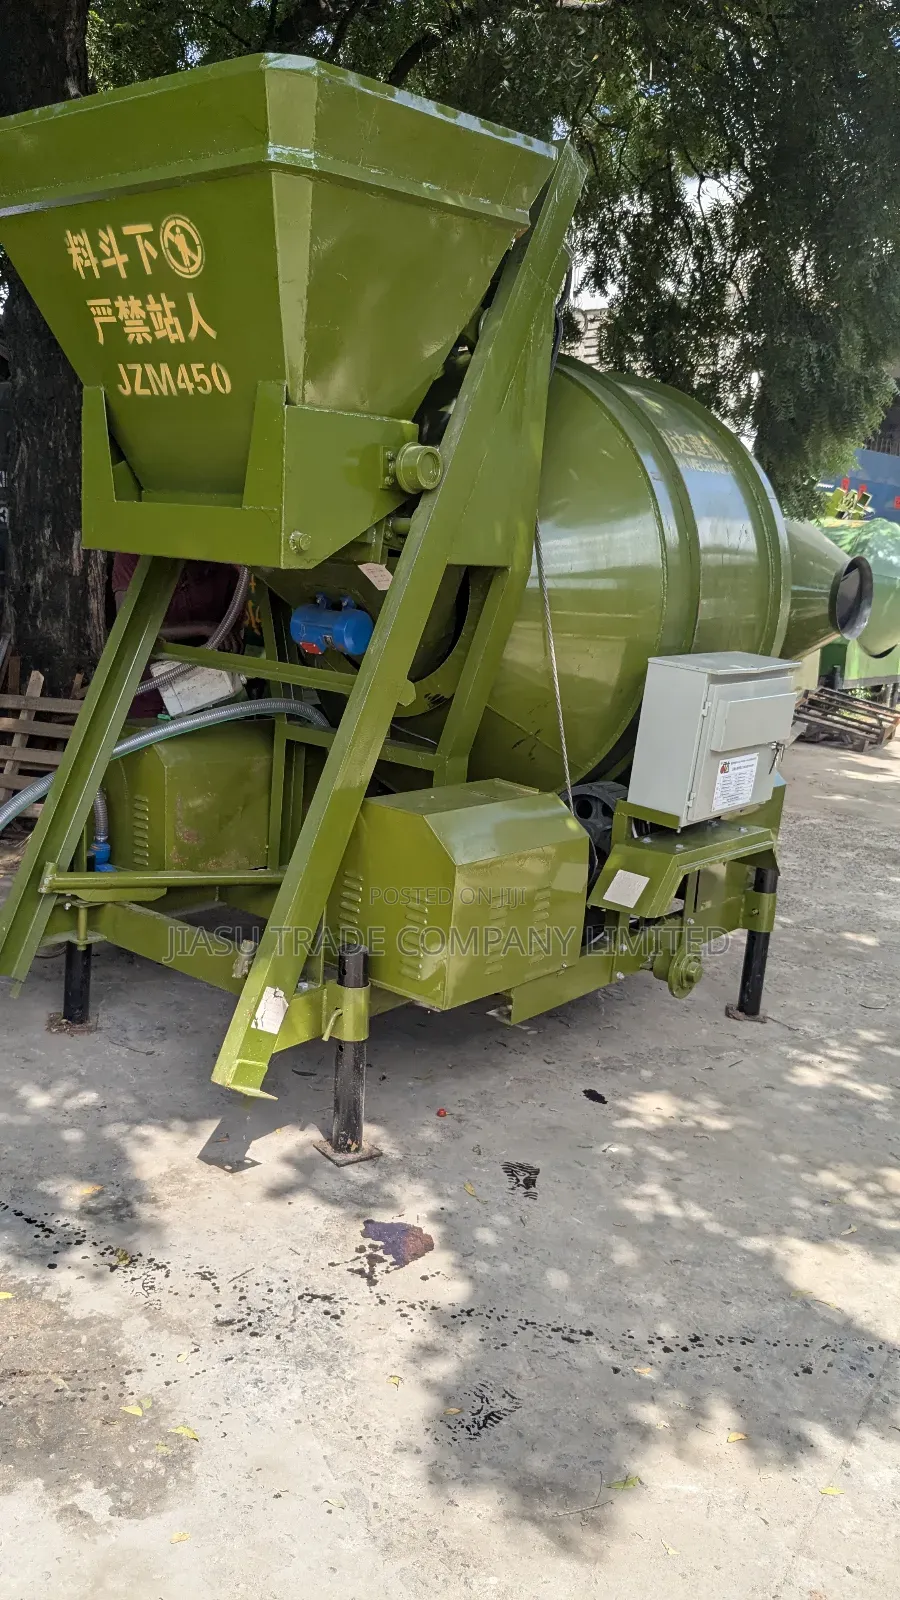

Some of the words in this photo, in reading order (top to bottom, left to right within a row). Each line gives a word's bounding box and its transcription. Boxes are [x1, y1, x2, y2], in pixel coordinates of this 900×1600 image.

[65, 223, 158, 279] 料斗下
[86, 292, 217, 345] 严禁站人
[117, 362, 231, 396] JZM450
